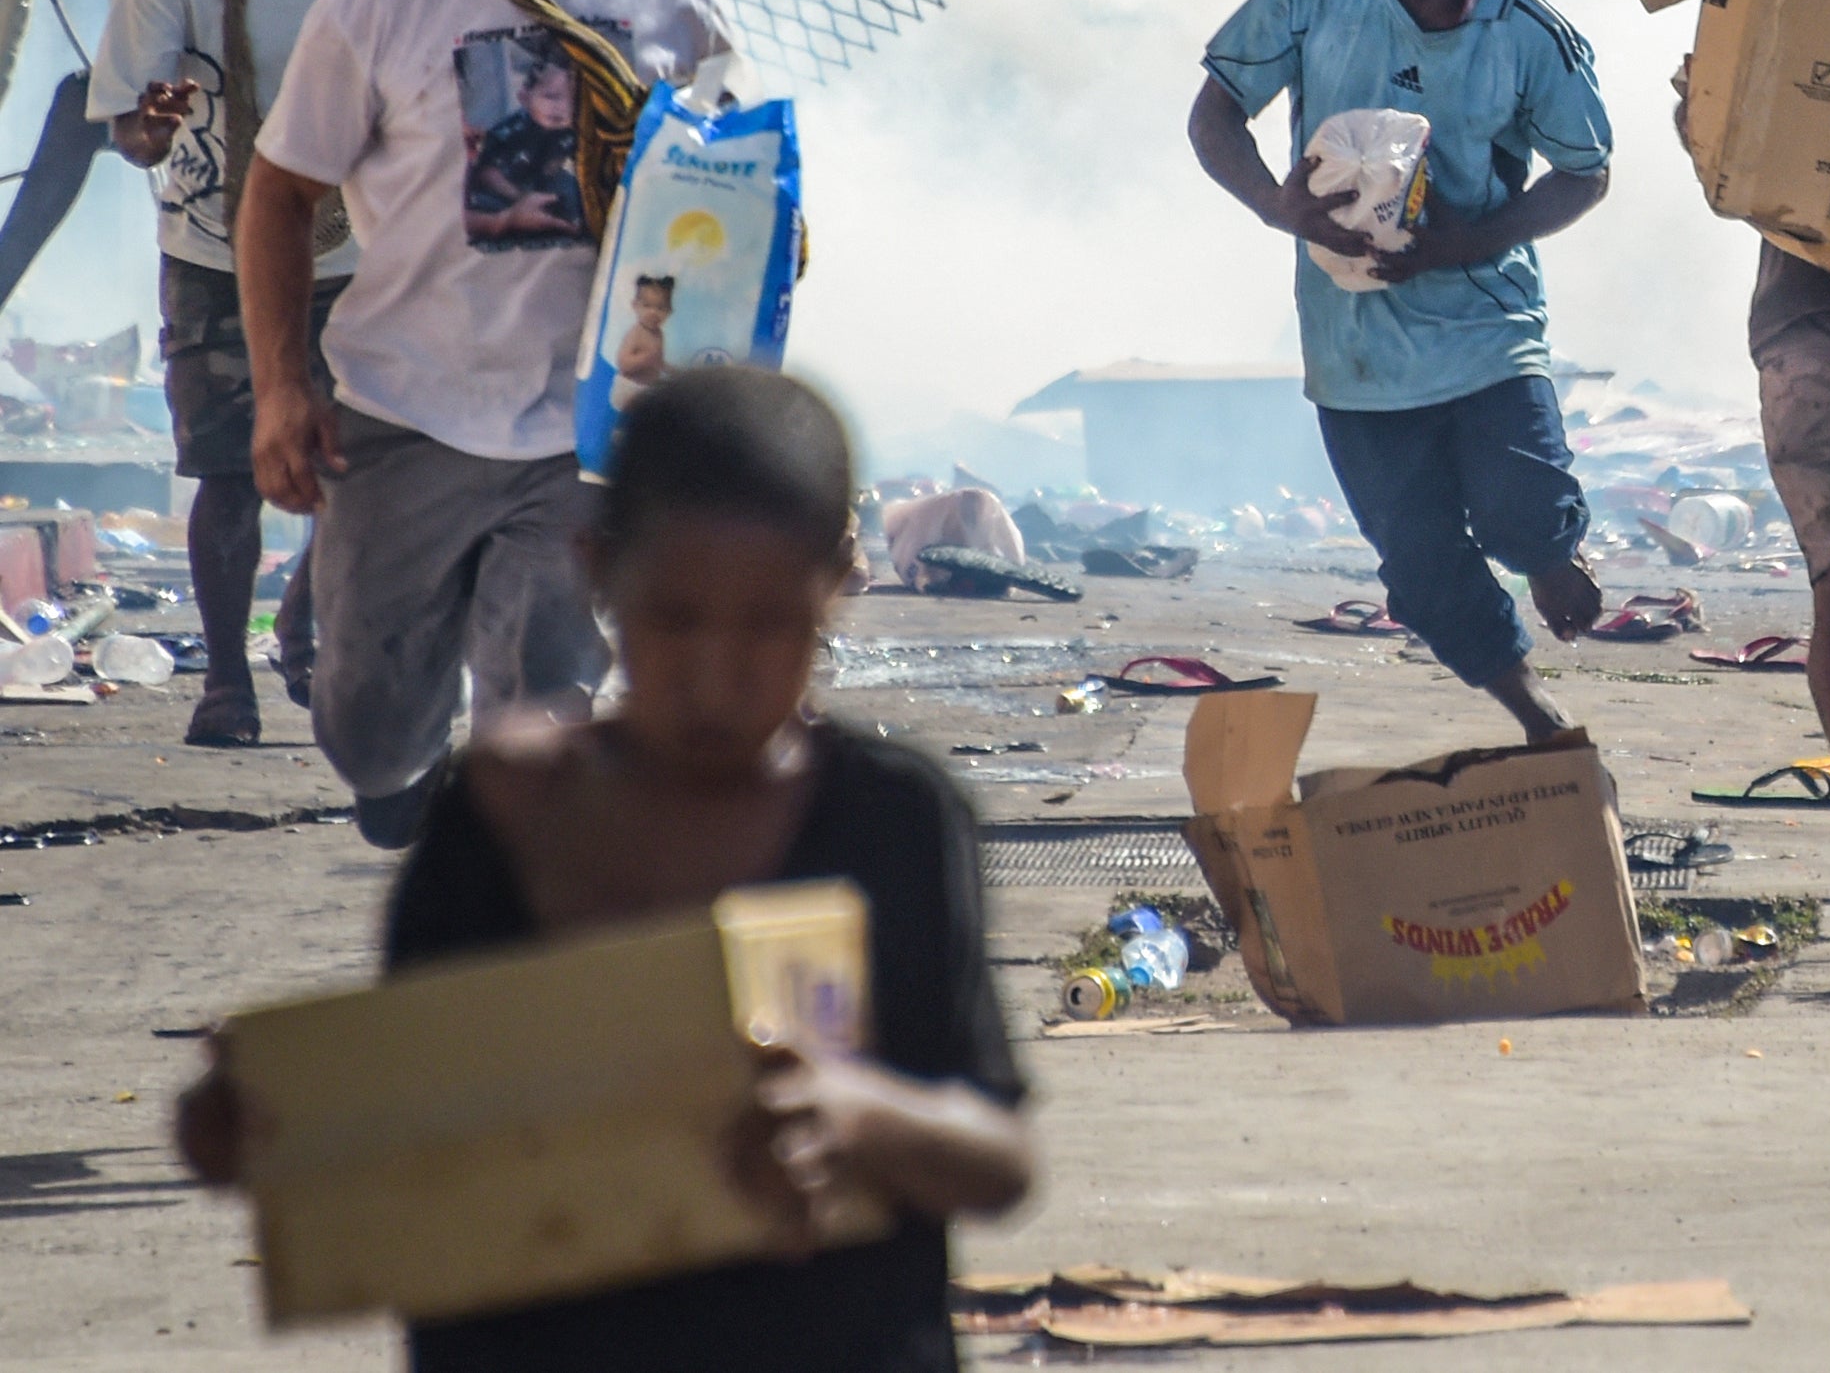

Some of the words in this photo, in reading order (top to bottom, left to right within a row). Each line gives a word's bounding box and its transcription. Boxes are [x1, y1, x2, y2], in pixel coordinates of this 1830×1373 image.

[1488, 794, 1505, 809] IN
[1509, 781, 1580, 804] BOTTLED
[1397, 807, 1431, 825] NEW
[1434, 797, 1485, 818] PAPUA
[1456, 806, 1526, 831] QUALITY
[1334, 814, 1393, 837] GUINEA
[1394, 822, 1453, 844] SPIRITS
[1485, 884, 1570, 952] TRADE
[1391, 917, 1482, 958] WINDS
